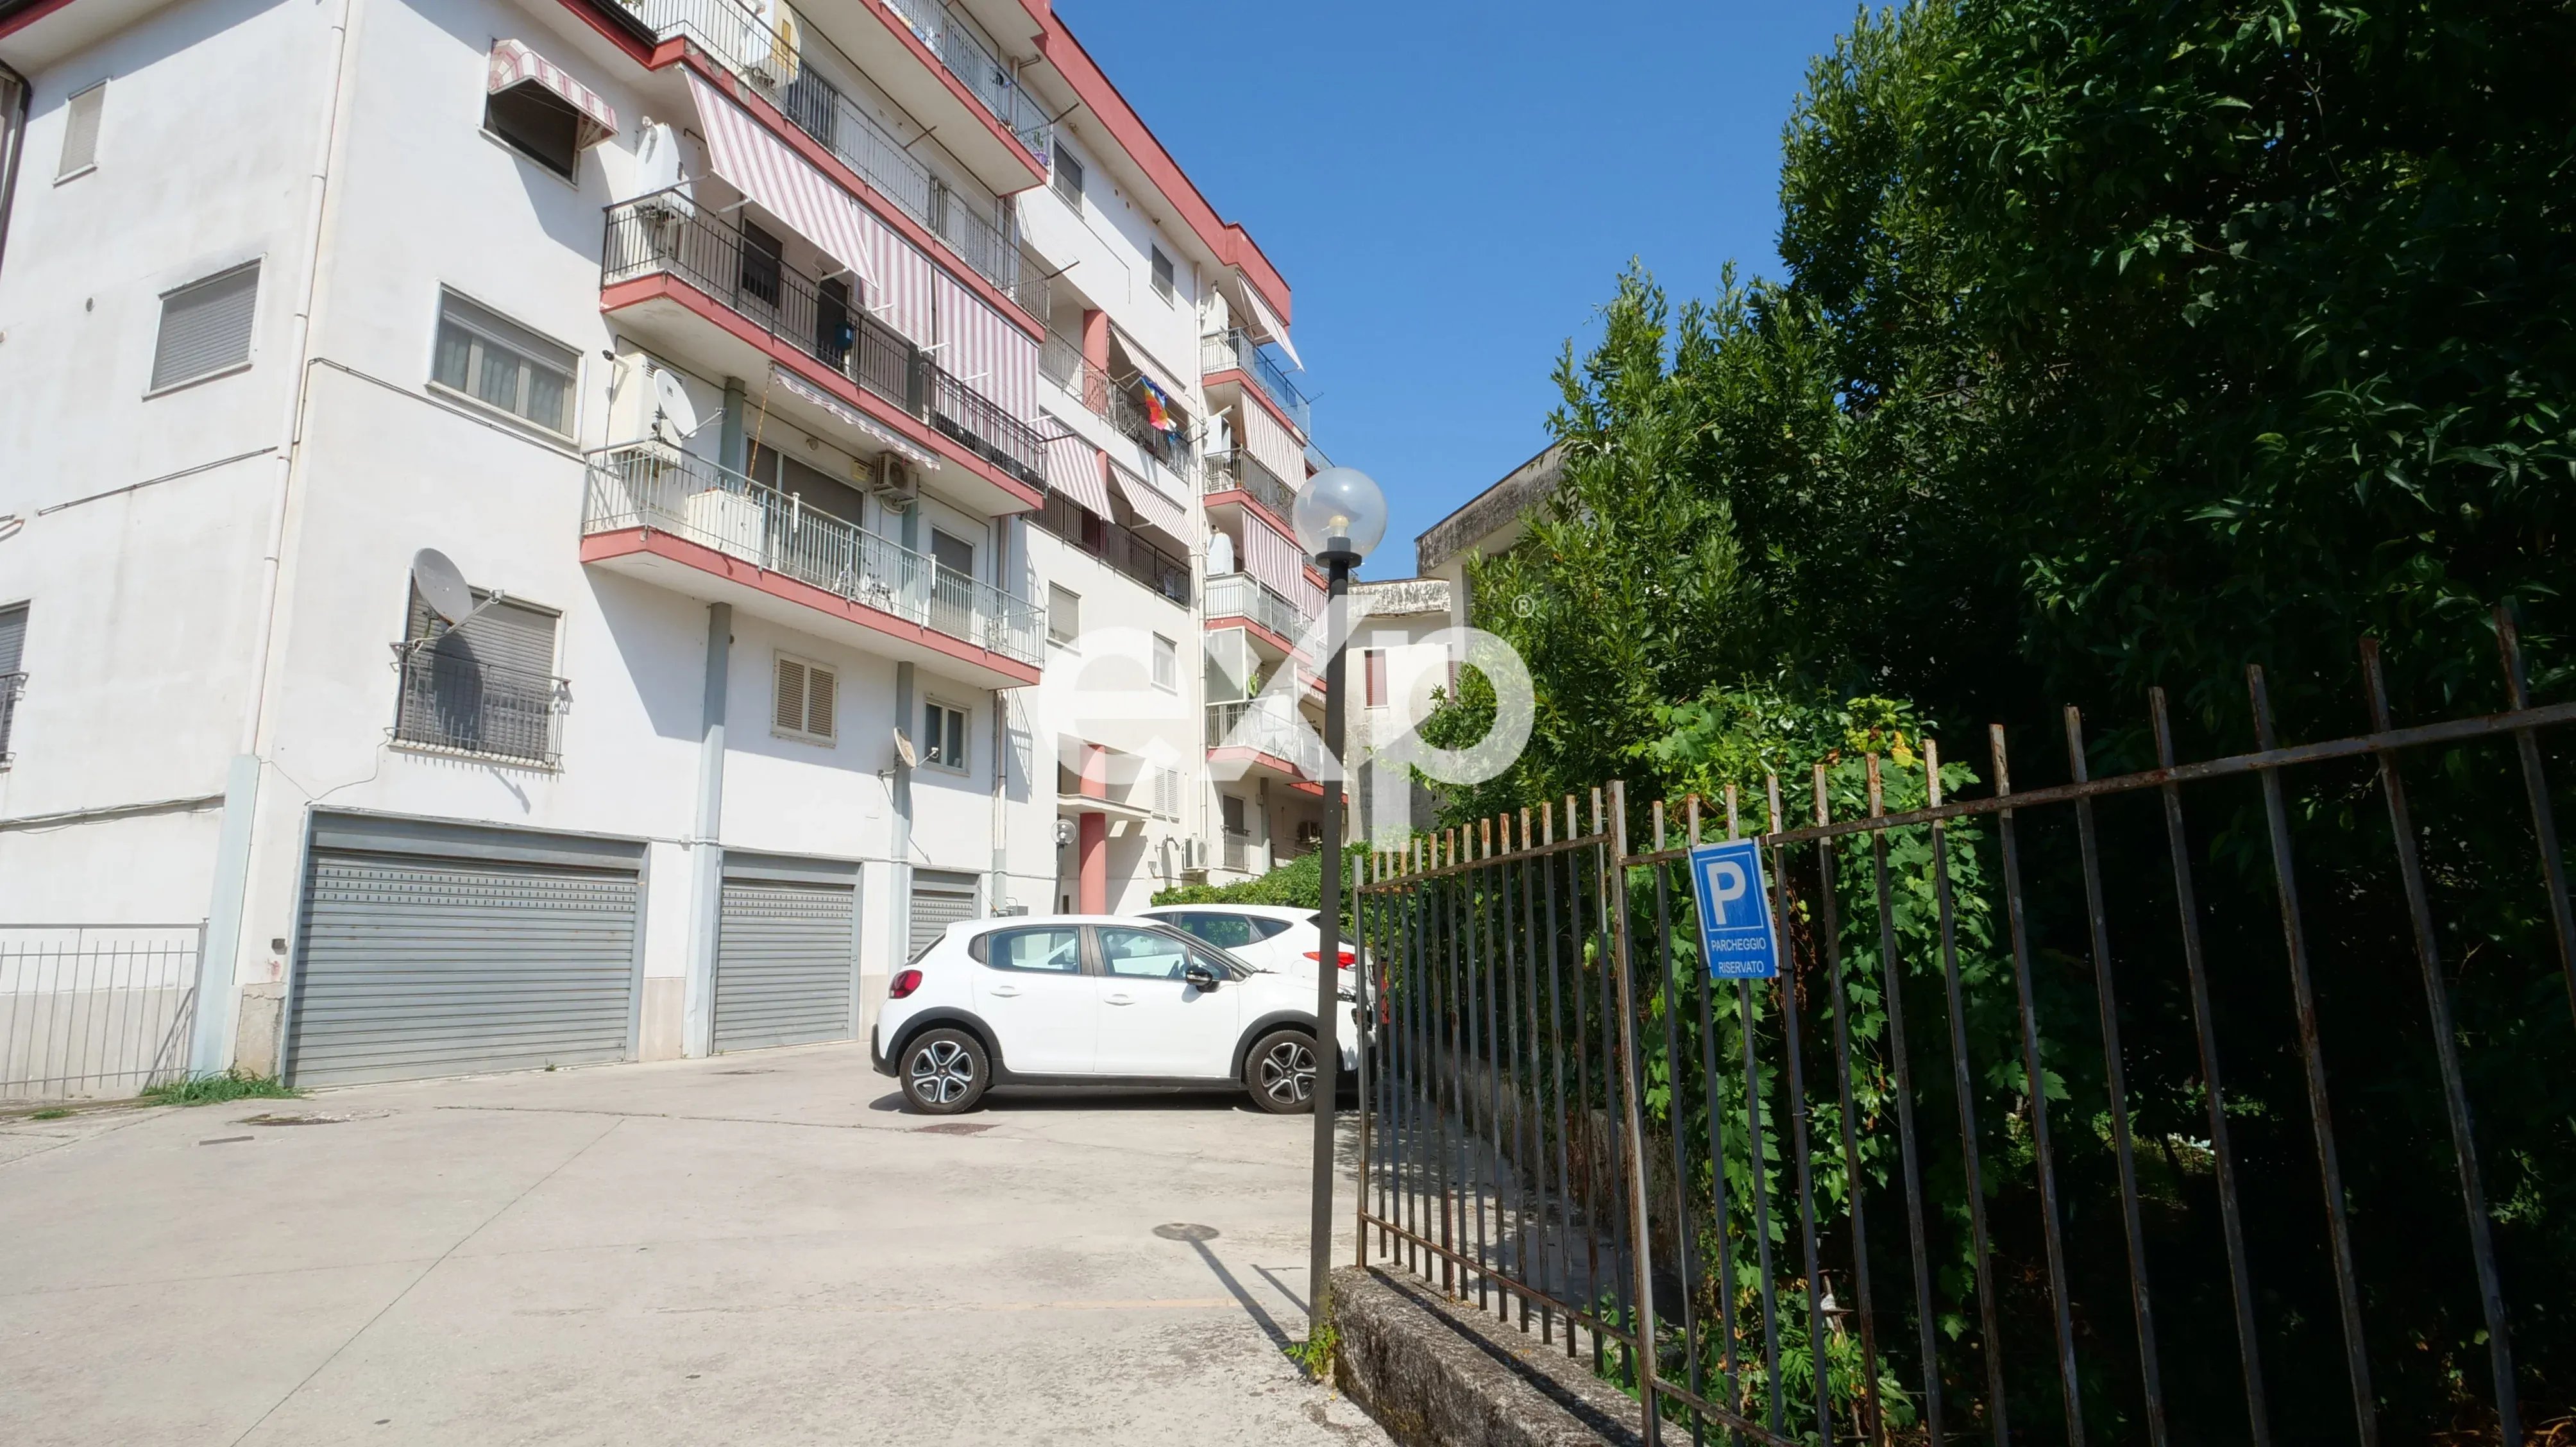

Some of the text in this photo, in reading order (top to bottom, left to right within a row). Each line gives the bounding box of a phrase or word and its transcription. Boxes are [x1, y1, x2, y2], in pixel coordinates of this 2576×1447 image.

[1706, 861, 1746, 925] P
[1711, 937, 1766, 952] PARCHEGGIO
[1718, 960, 1765, 974] RISERVATO
